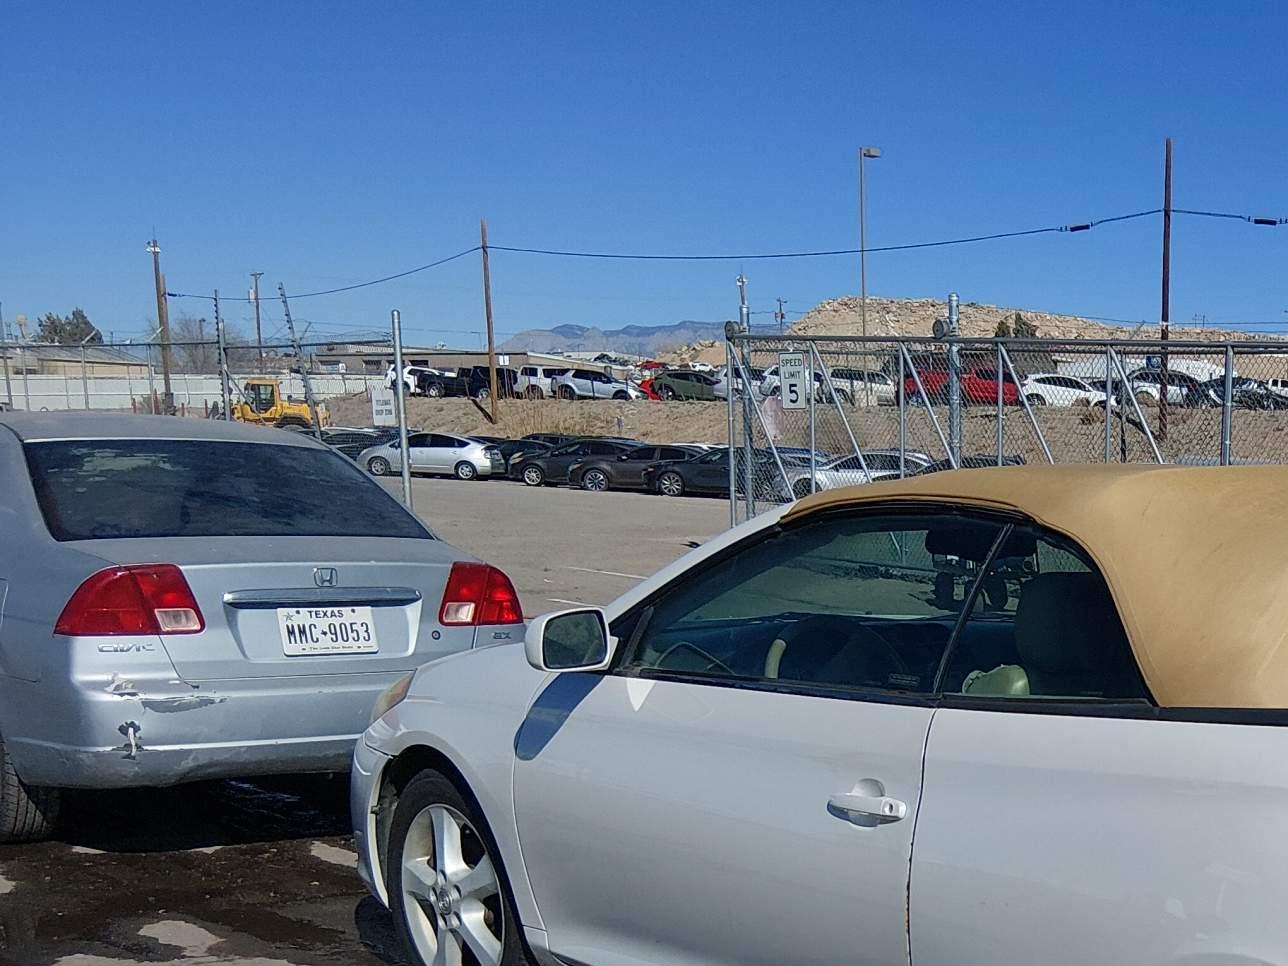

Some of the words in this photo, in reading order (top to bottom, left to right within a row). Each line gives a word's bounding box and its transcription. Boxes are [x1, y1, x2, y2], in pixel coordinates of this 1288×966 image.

[781, 359, 802, 367] SPEED
[783, 370, 801, 379] LIMIT
[788, 383, 799, 404] 5
[307, 609, 344, 619] TEXAS
[98, 644, 156, 653] CIVIC
